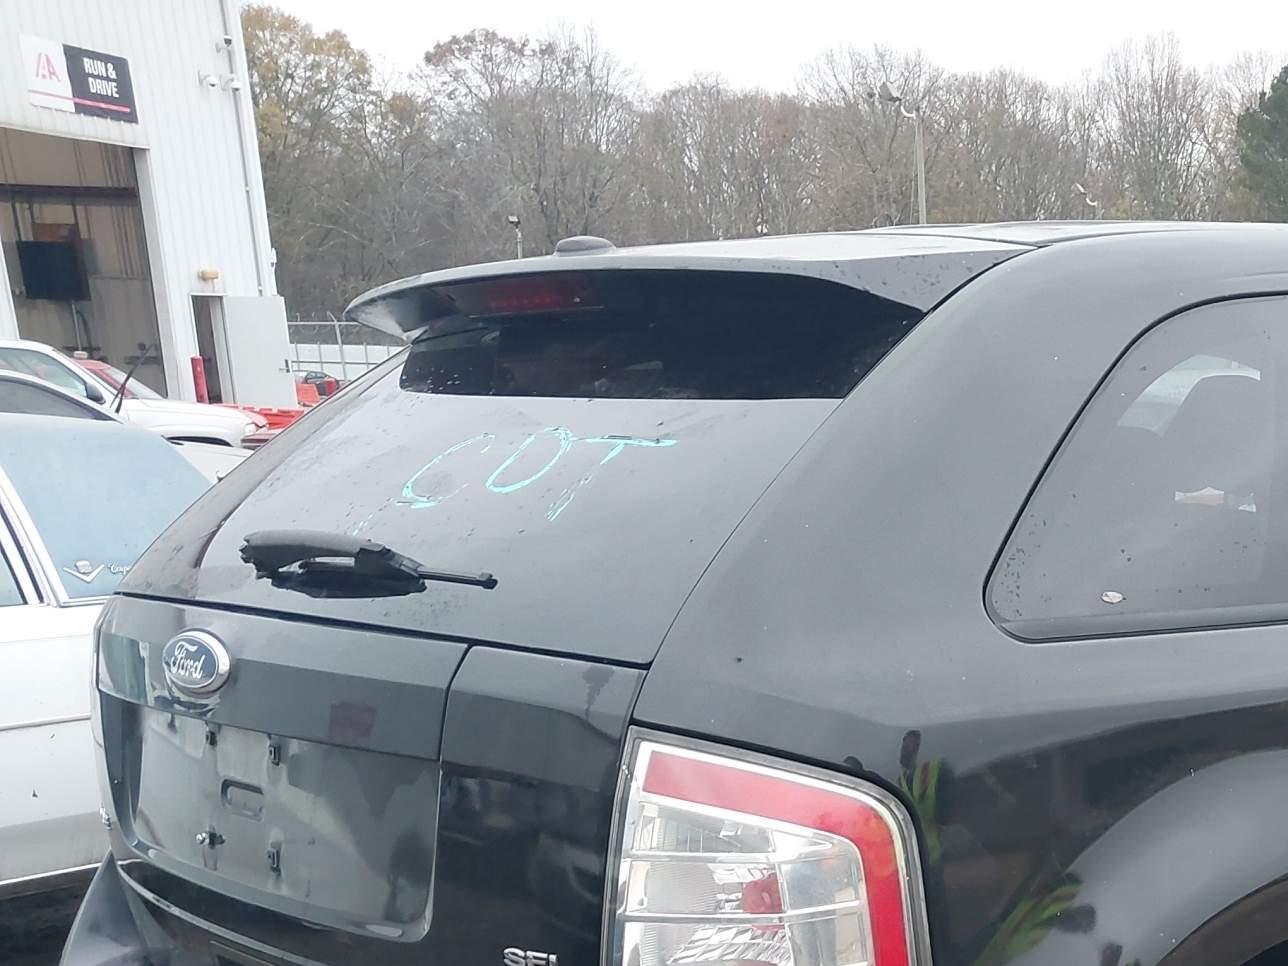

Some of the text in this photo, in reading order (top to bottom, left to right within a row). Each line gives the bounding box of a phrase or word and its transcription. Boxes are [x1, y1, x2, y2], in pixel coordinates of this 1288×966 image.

[83, 57, 117, 79] RUN &
[88, 76, 119, 98] DRIVE
[170, 641, 206, 679] Ford
